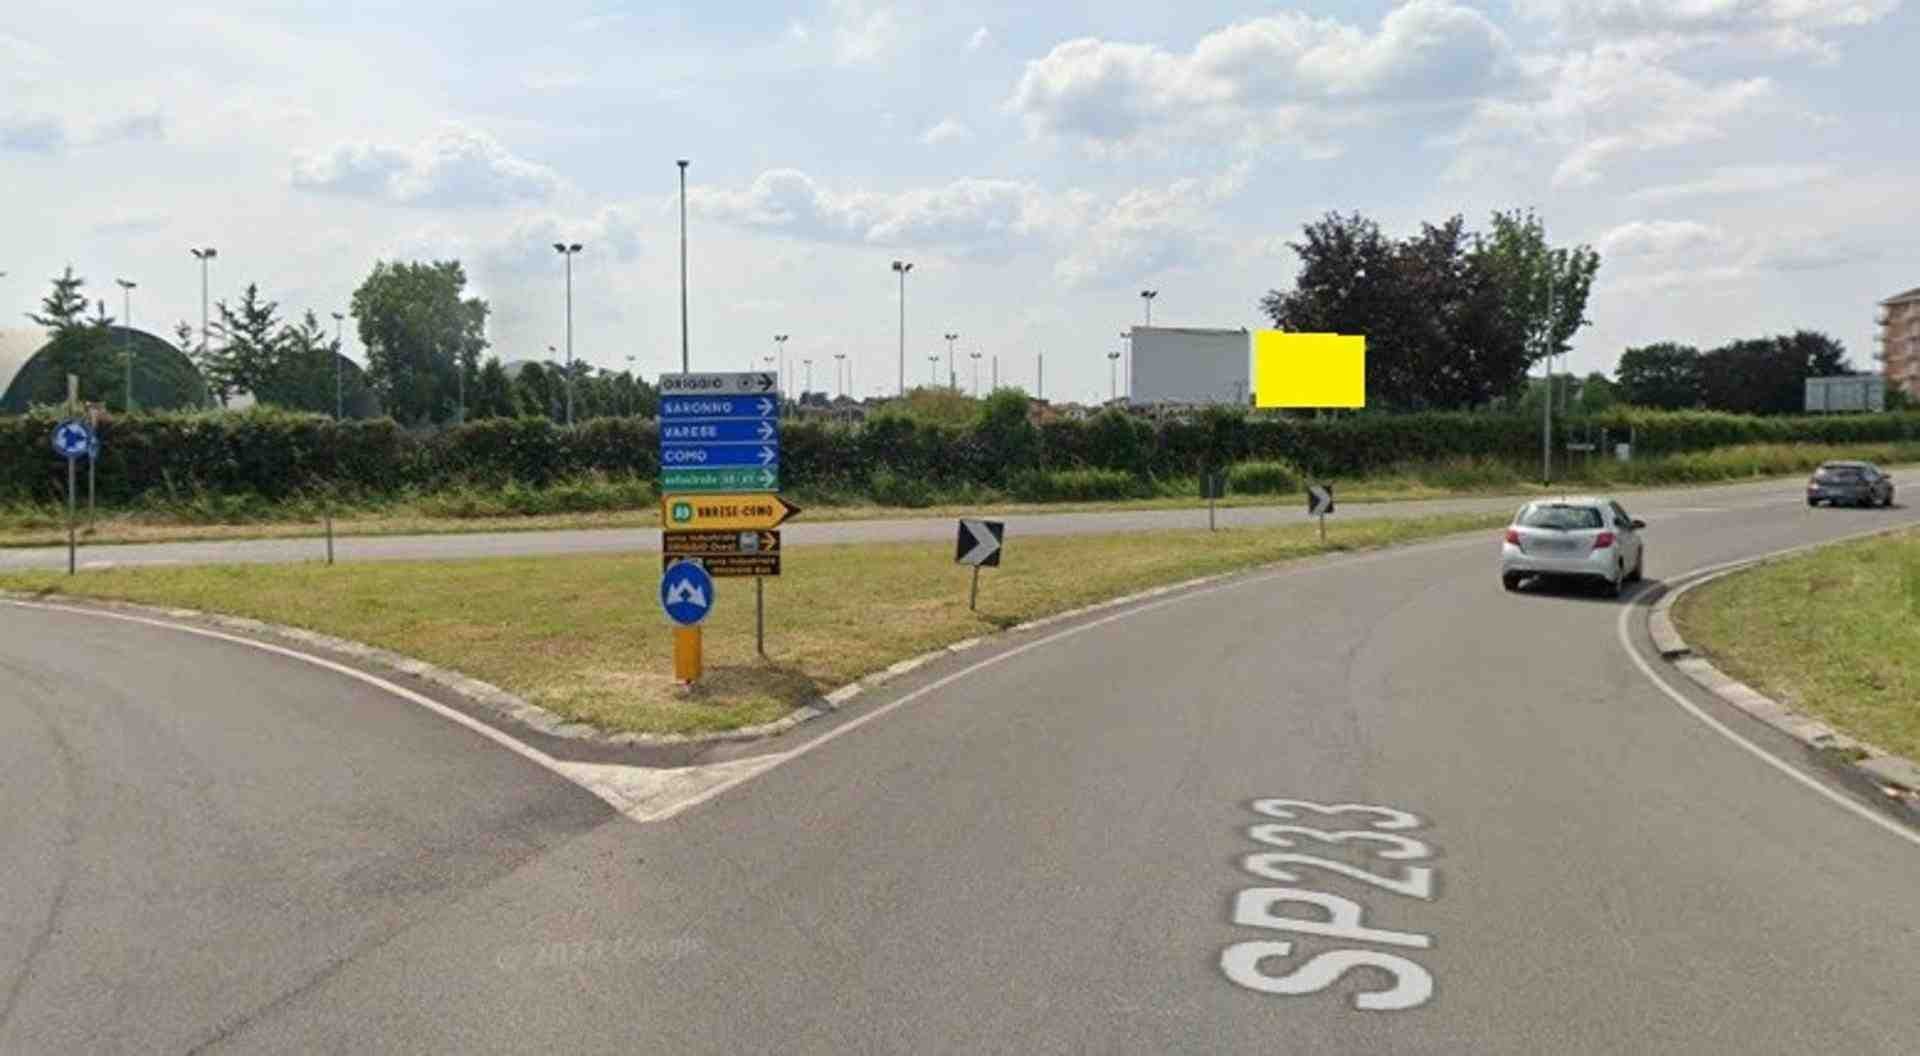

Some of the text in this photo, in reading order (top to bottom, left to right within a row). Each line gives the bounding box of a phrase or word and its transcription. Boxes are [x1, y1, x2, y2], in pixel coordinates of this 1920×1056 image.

[663, 401, 733, 414] SARONNO
[663, 425, 718, 438] VARESE
[664, 449, 707, 462] COMO
